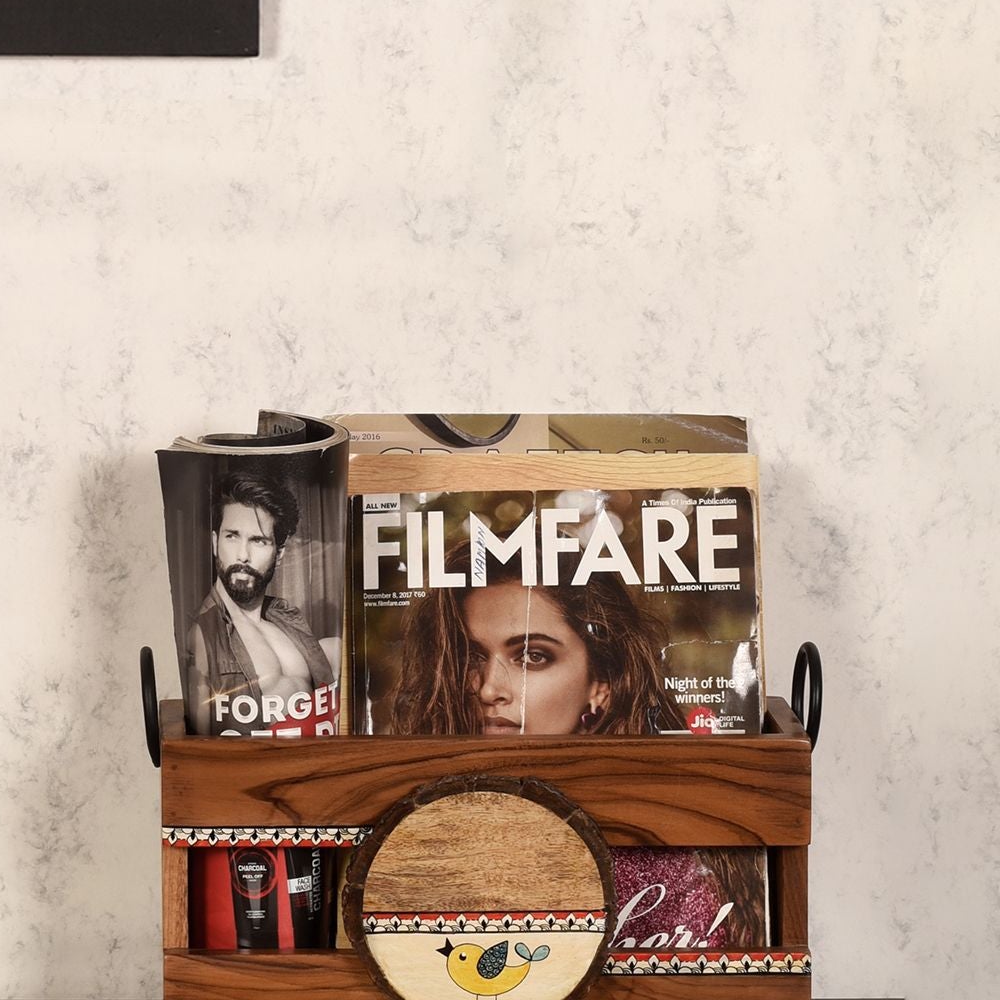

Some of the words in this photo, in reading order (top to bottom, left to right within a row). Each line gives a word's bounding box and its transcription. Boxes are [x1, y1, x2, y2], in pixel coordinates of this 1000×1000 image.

[363, 505, 740, 590] FILMFARE
[664, 677, 698, 692] Night
[701, 677, 713, 689] of
[716, 677, 735, 688] the
[215, 680, 338, 724] FORGET
[675, 691, 725, 703] winners!
[691, 714, 714, 728] Jio
[238, 864, 267, 872] CHARCOAL
[297, 877, 310, 885] FACE
[311, 847, 321, 911] CHARCOA
[295, 883, 311, 892] WASH
